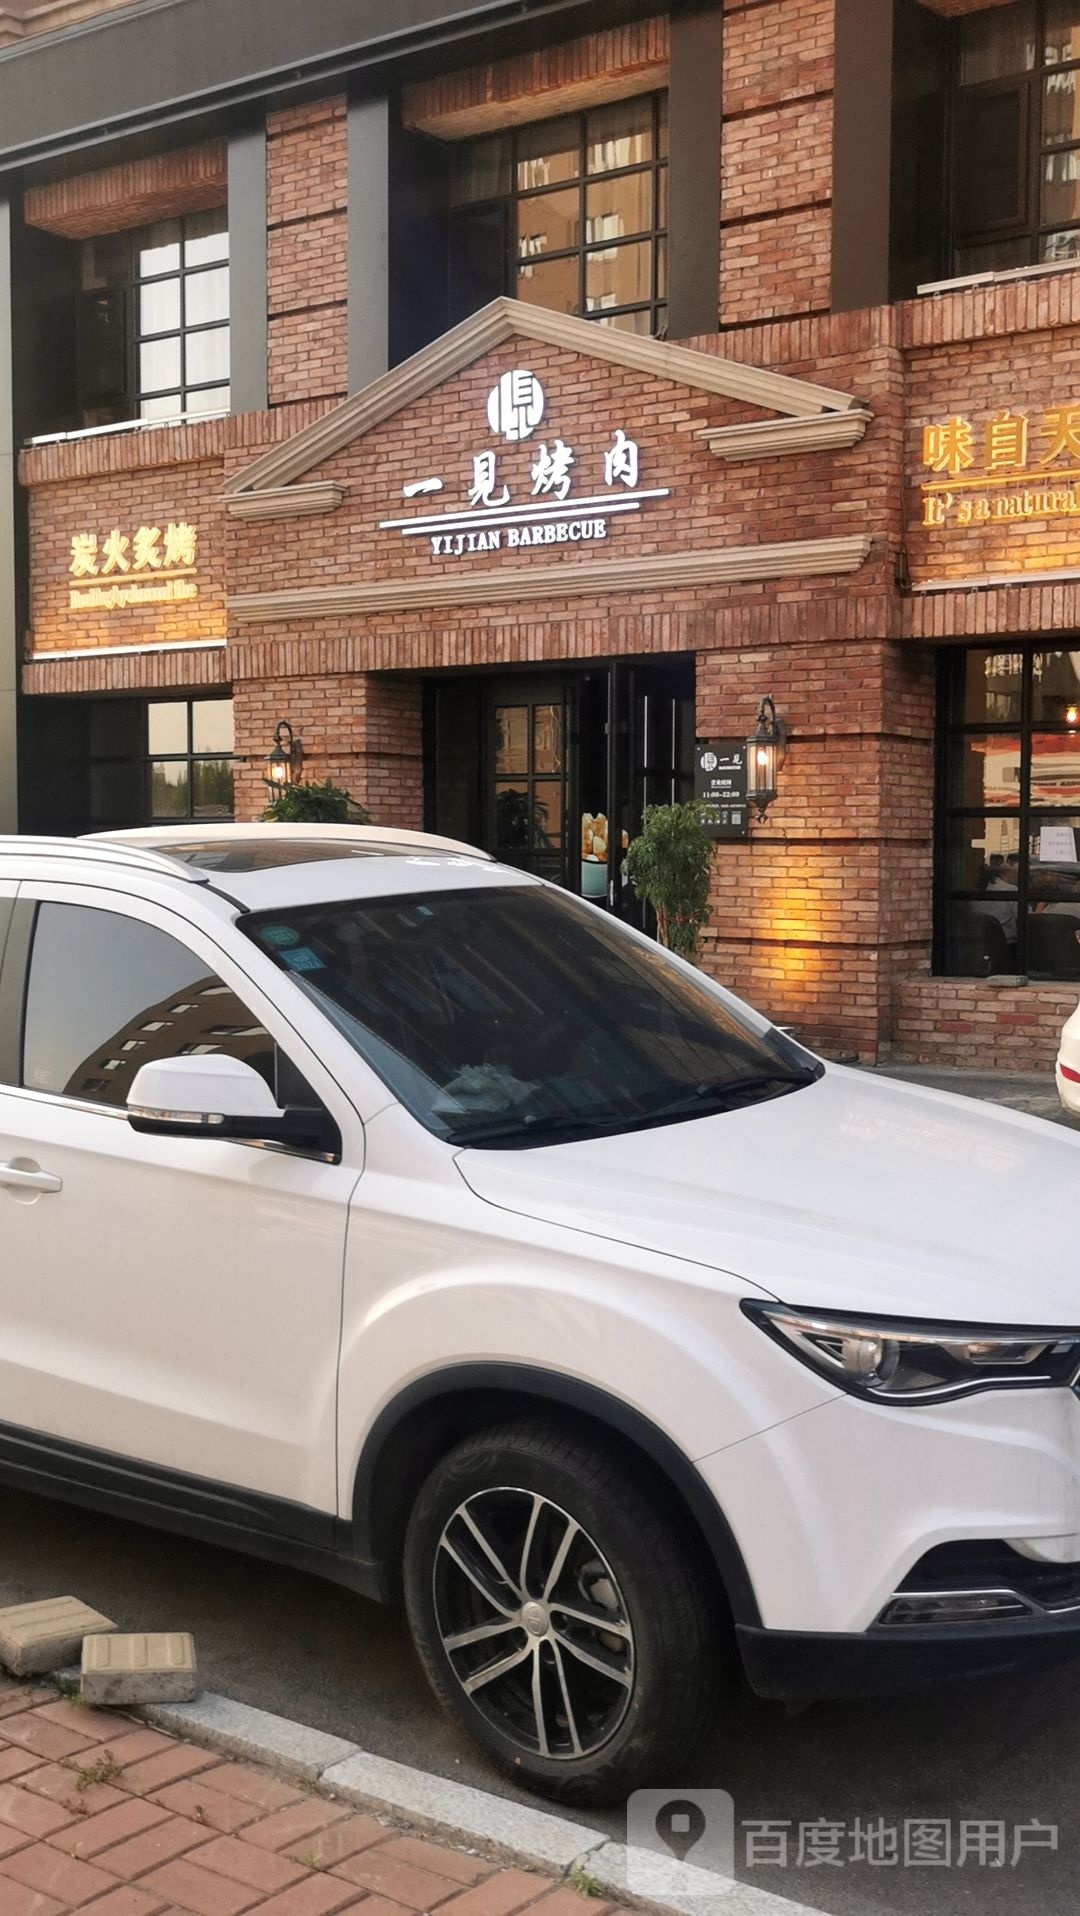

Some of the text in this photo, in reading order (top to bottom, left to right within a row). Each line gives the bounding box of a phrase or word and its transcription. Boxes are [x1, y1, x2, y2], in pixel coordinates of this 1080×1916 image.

[69, 521, 197, 577] 炭火炙烤
[431, 519, 606, 555] YIJIAN BARBECUE
